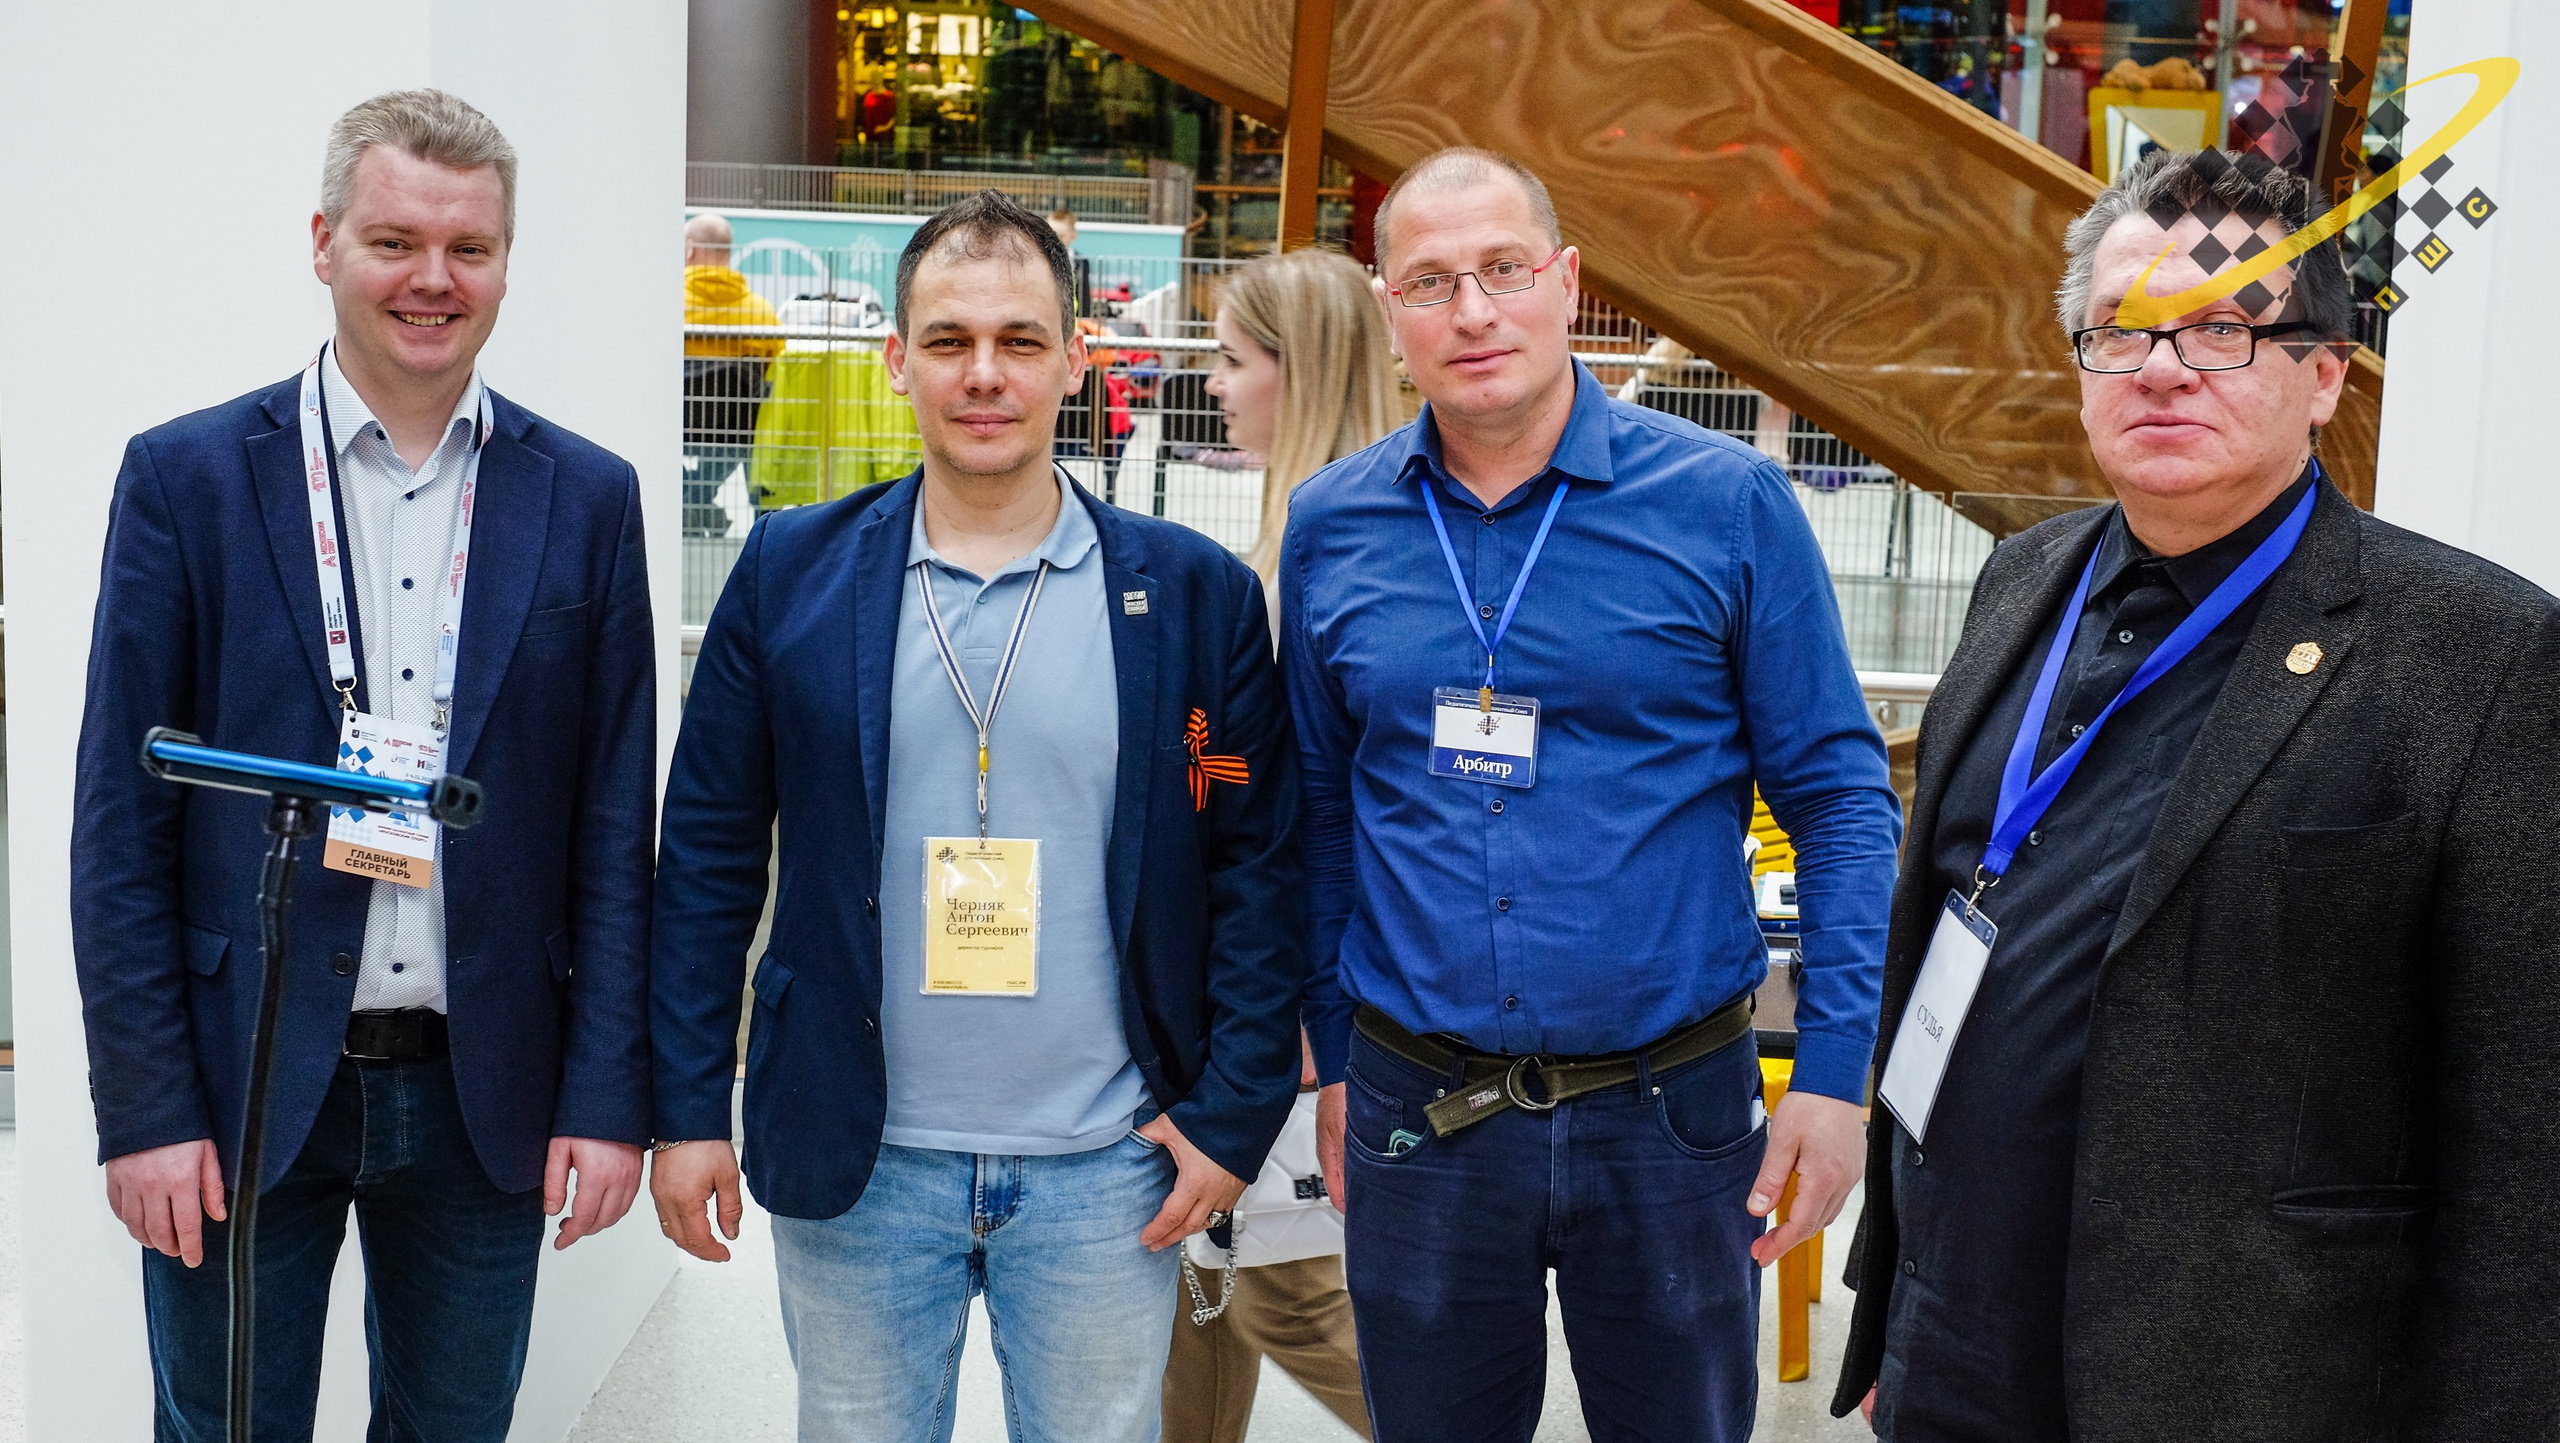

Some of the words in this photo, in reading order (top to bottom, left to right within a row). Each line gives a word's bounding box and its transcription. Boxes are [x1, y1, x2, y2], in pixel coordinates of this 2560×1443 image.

[316, 520, 328, 555] МОСКОВСКИЙ
[327, 538, 336, 554] СПОРТ
[1453, 754, 1513, 778] Арбитр
[344, 858, 411, 879] СЕКРЕТАРЬ
[350, 848, 408, 869] ГЛАВНЫЙ
[946, 898, 1006, 914] Черняк
[946, 911, 995, 923] Антон
[946, 923, 1028, 939] Сергеевич
[1917, 1004, 1944, 1043] СУДЬЯ
